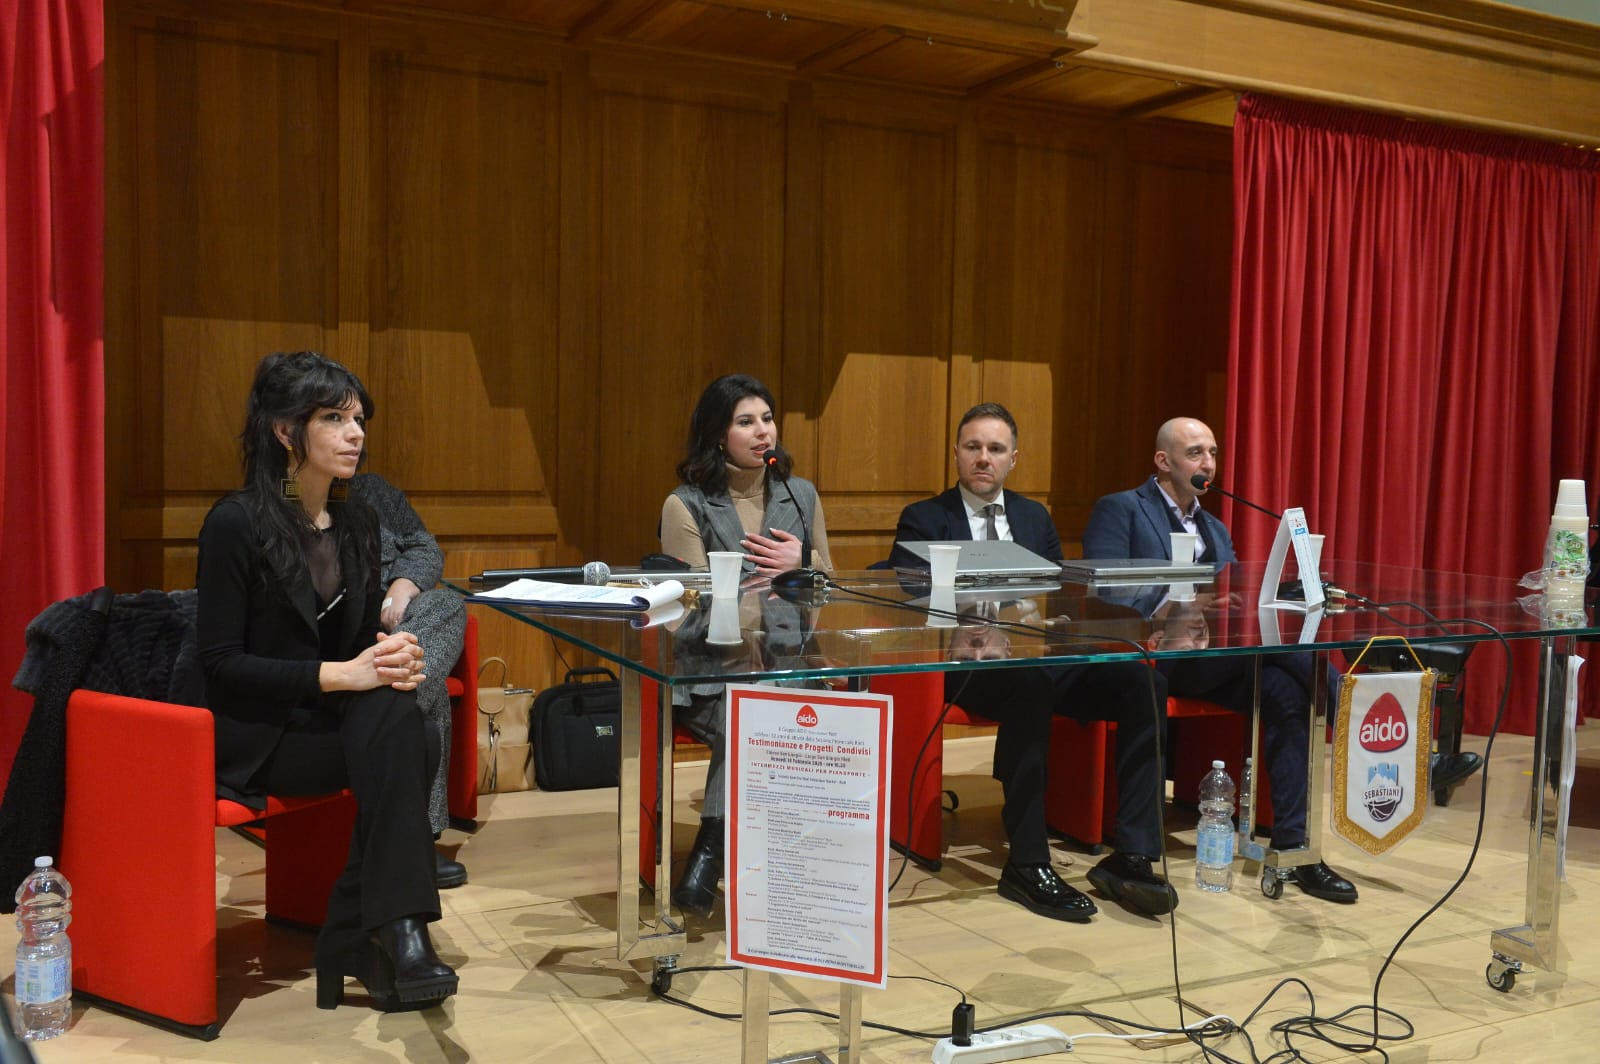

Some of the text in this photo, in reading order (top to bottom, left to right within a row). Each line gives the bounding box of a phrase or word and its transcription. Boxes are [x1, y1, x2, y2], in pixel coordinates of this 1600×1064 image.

[798, 714, 817, 724] aido
[1360, 716, 1406, 742] aido
[749, 738, 797, 749] Testimonianze
[805, 743, 833, 754] Progetti
[837, 745, 870, 756] Condivisi
[1364, 788, 1400, 800] SEBASTIANI
[828, 809, 870, 821] programma
